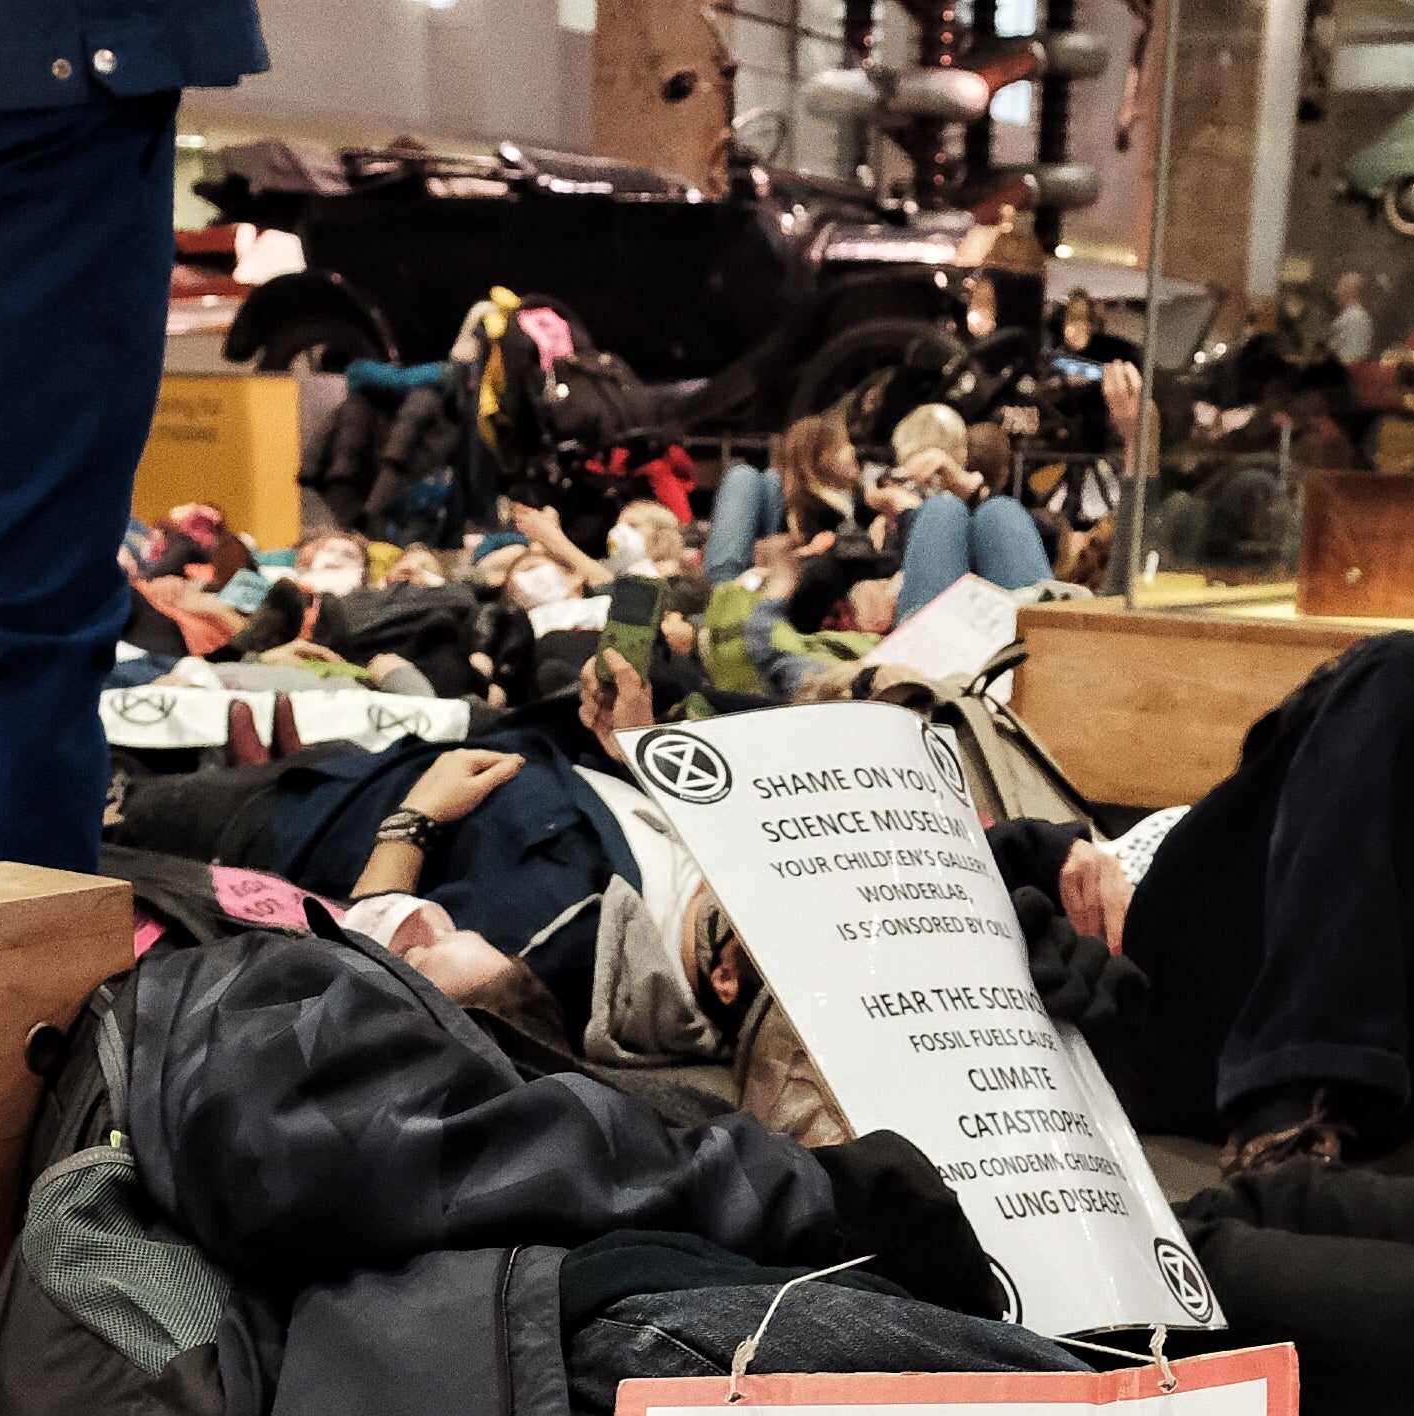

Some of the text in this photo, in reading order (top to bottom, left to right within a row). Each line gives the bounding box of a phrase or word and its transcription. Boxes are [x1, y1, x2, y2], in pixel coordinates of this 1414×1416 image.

[753, 767, 944, 800] SHAME ON YOU,
[761, 811, 870, 843] SCIENCE
[770, 856, 833, 878] YOUR
[857, 882, 974, 904] WONDERLAB,
[836, 923, 858, 941] IS
[965, 916, 986, 935] BY
[861, 987, 1048, 1019] HEAR THE SCIENC
[910, 1030, 970, 1053] FOSSIL
[970, 1029, 1018, 1048] FUELS
[967, 1066, 1057, 1092] CLIMATE
[958, 1109, 1094, 1139] CATASTROPHE
[936, 1161, 977, 1182] AND
[979, 1153, 1064, 1177] CONDEMN
[995, 1190, 1060, 1220] LUNG
